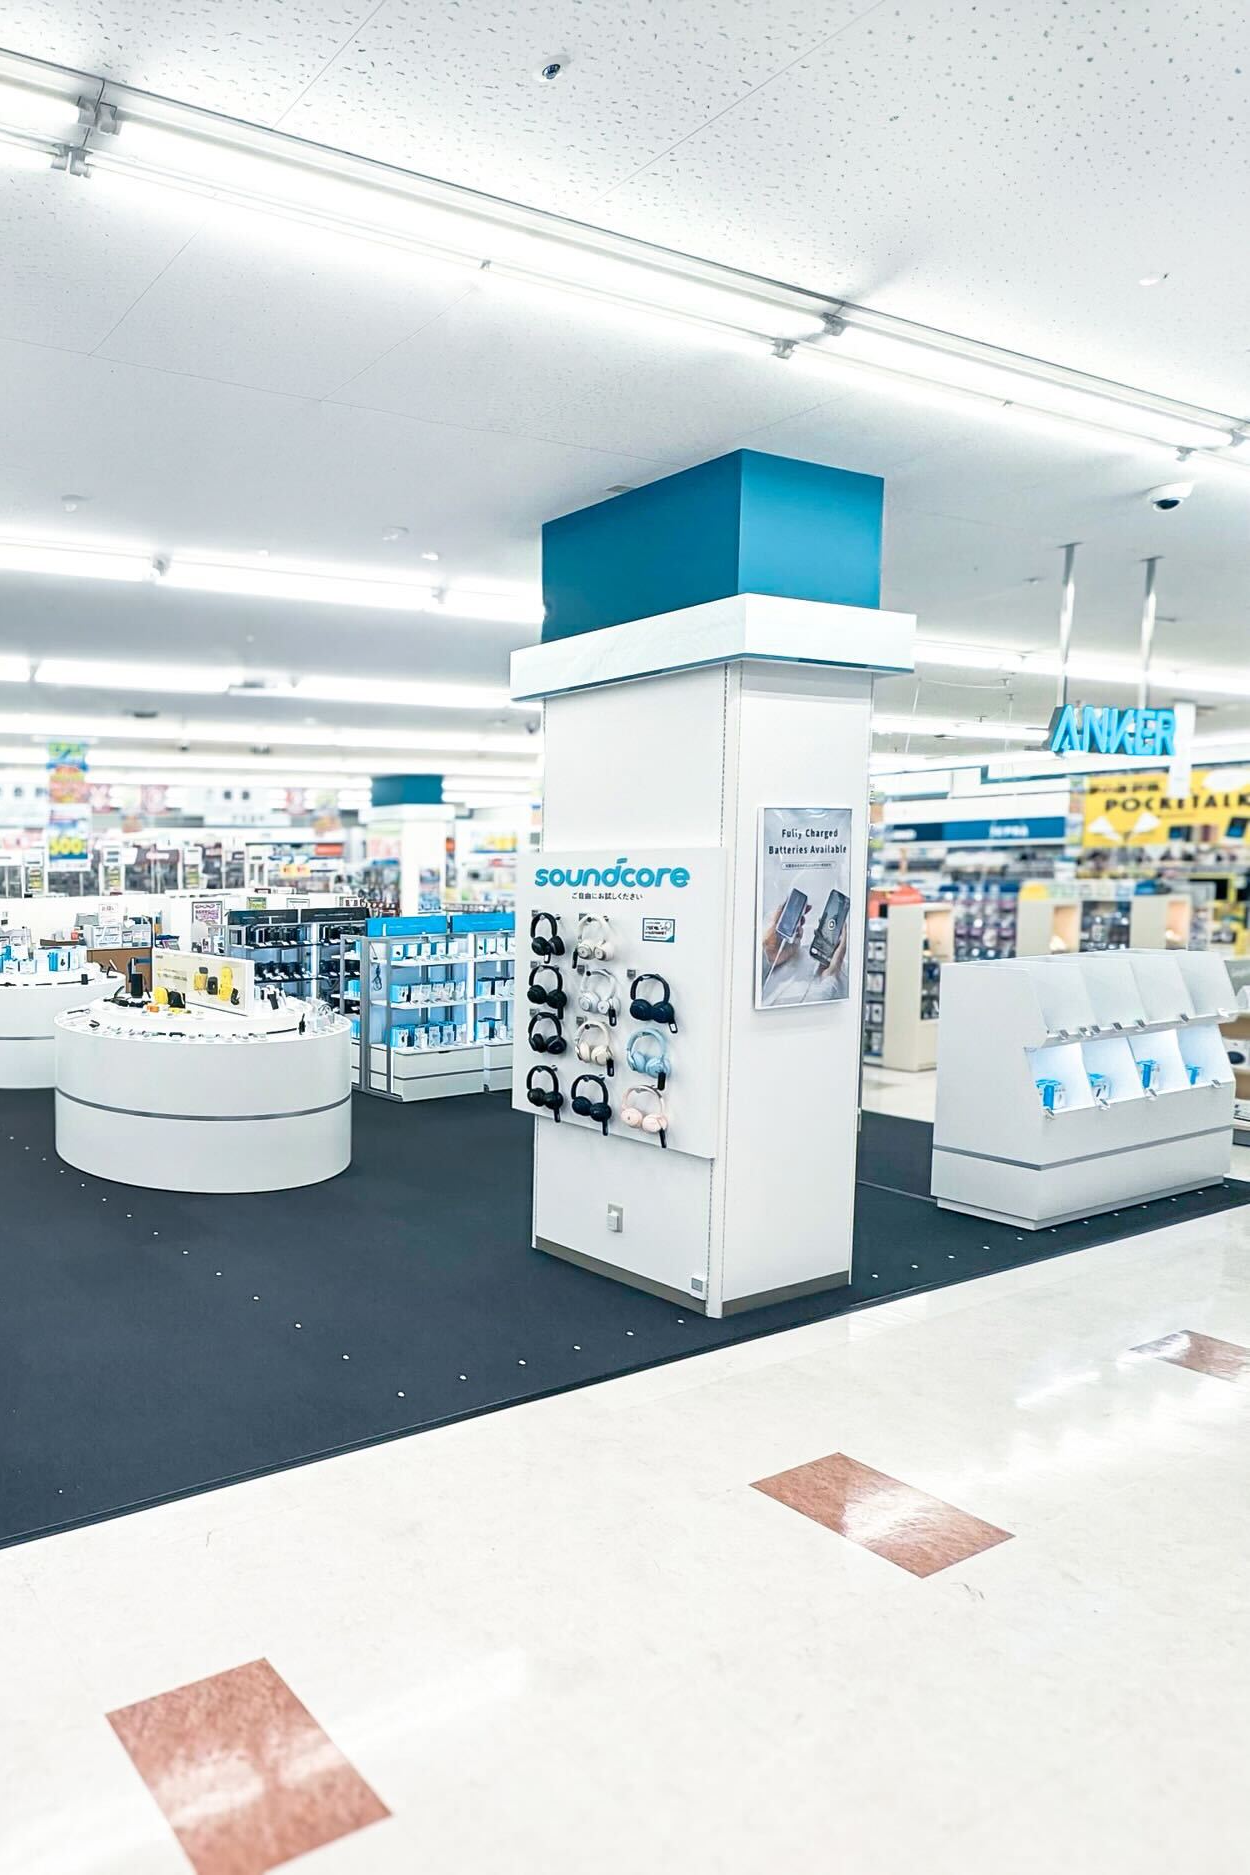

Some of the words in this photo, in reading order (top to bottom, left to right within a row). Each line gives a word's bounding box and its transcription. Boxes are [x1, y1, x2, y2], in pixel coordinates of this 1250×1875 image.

[1051, 704, 1176, 757] ANKER
[805, 828, 838, 839] Charged
[768, 845, 808, 854] Batteries
[810, 844, 847, 854] Available
[535, 858, 691, 888] soundcore
[572, 892, 643, 901] ご自由にお試しください
